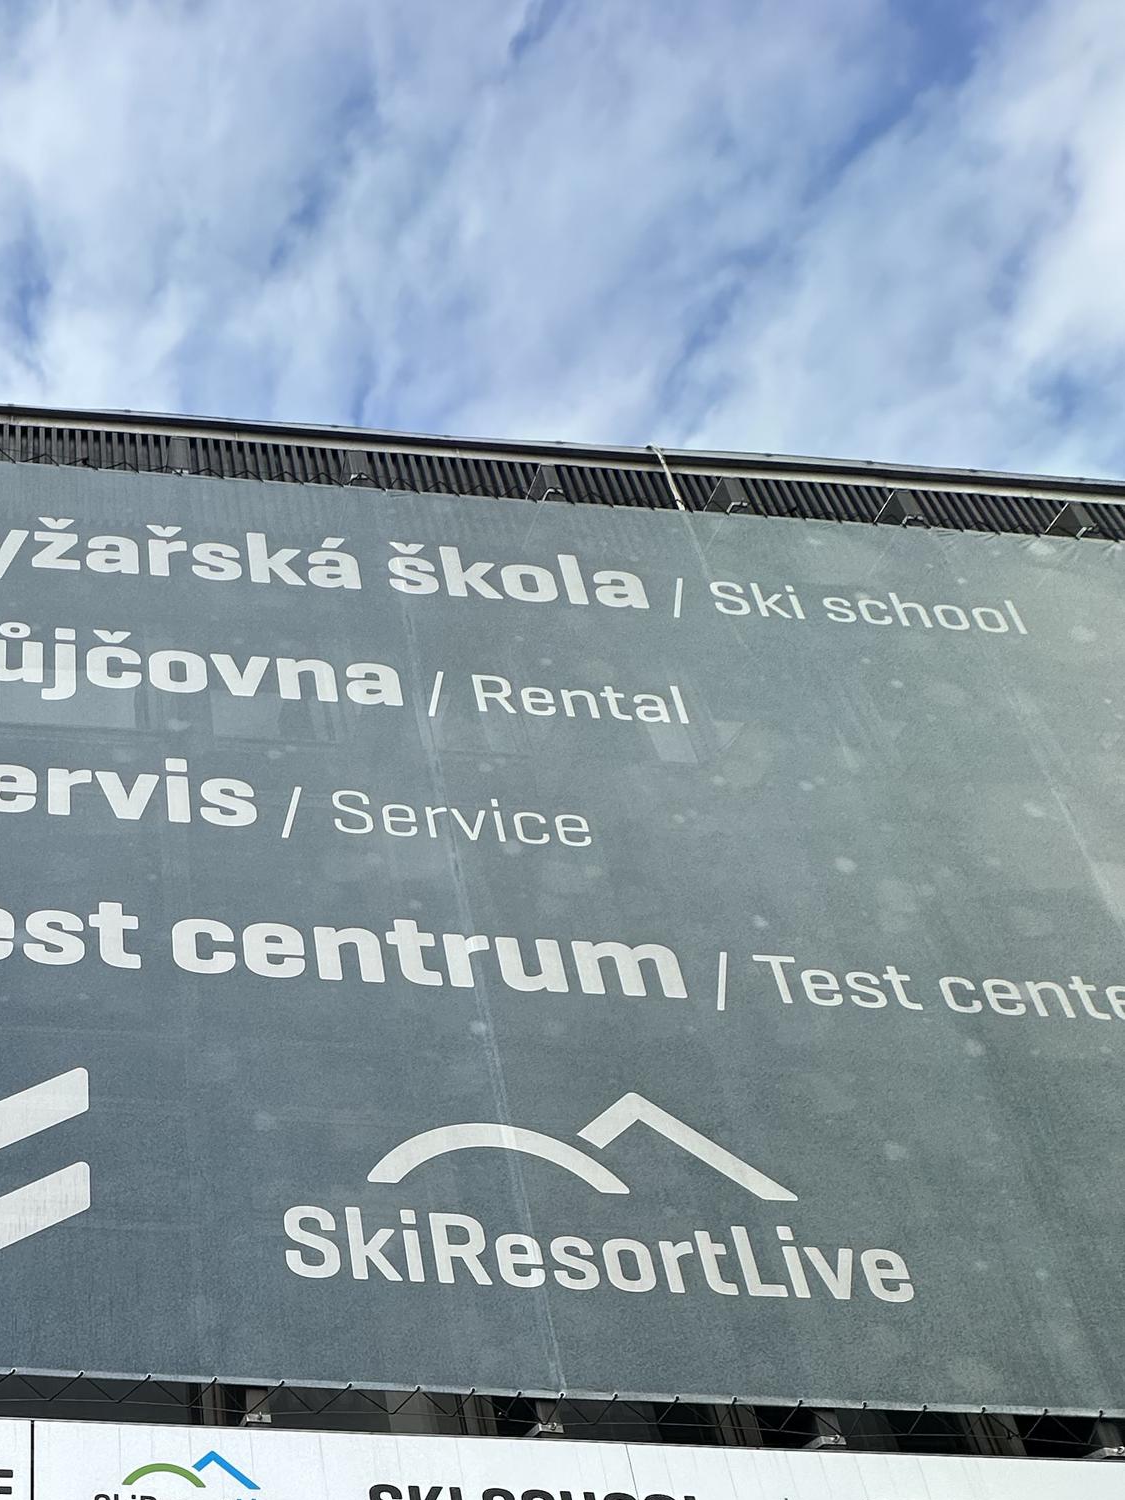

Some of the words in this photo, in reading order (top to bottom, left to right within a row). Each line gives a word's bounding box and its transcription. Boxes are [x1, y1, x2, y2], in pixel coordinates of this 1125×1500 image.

[387, 541, 650, 609] škola
[709, 581, 805, 620] Ski
[822, 591, 1028, 635] school
[472, 674, 690, 724] Rental
[332, 789, 592, 847] Service
[171, 917, 689, 999] centrum
[752, 953, 923, 1011] Test
[283, 1206, 915, 1304] SkiResortLive
